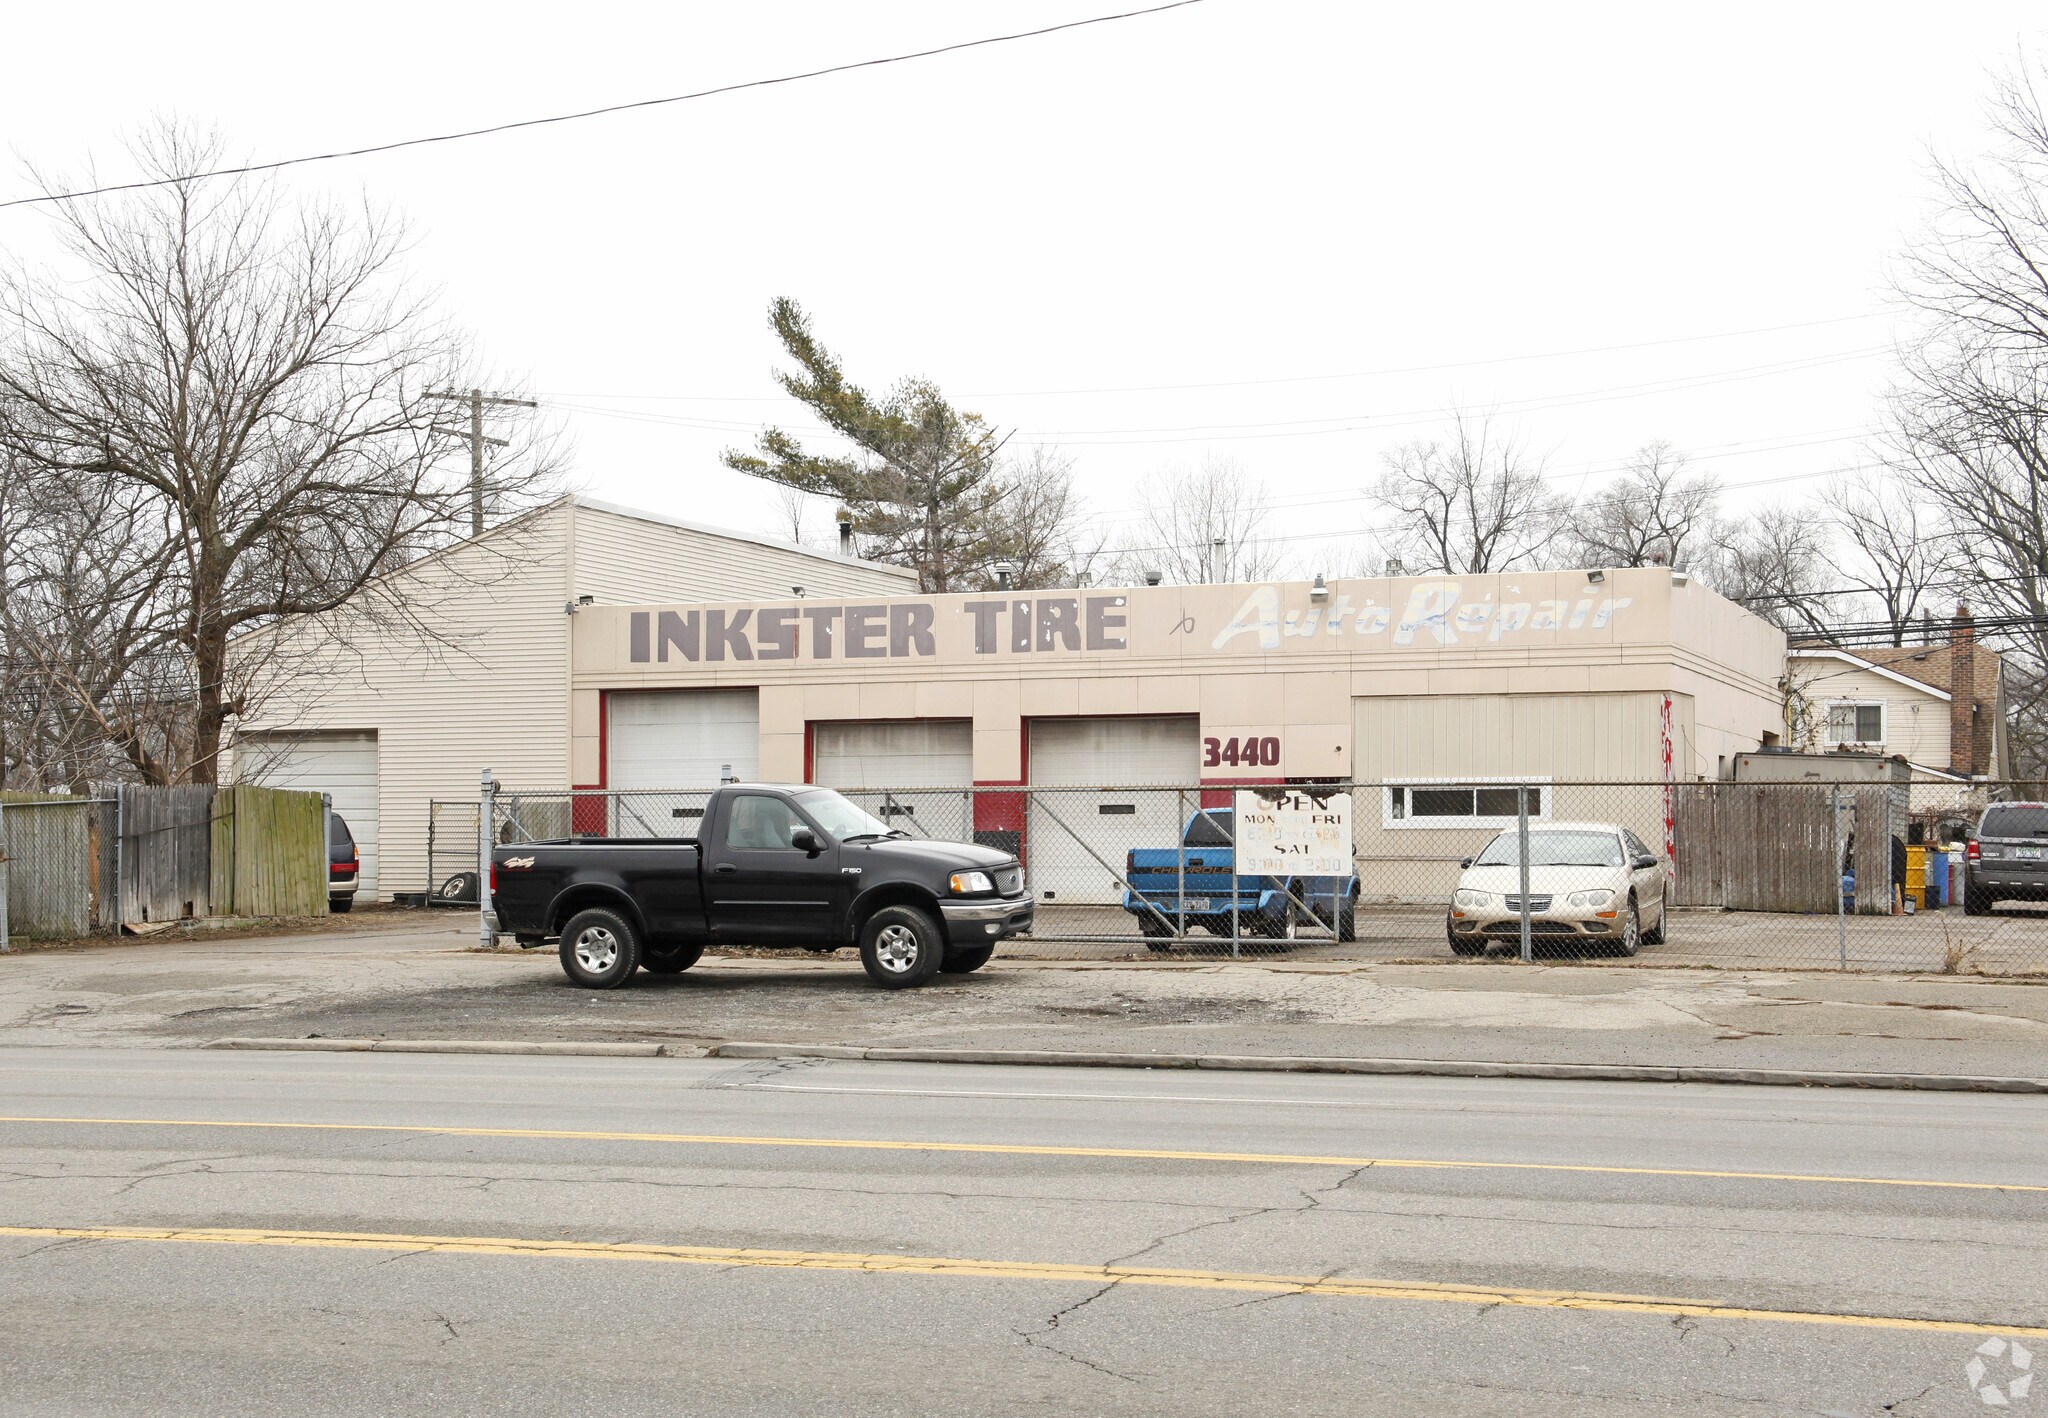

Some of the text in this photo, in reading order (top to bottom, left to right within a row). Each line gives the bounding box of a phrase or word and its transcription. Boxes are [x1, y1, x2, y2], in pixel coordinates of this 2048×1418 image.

[630, 603, 936, 663] INKSTER
[964, 596, 1127, 655] TIRE
[1211, 585, 1393, 651] Auto
[1393, 582, 1633, 647] Repair
[1203, 737, 1280, 767] 3440
[1256, 795, 1328, 811] OPEN
[1244, 814, 1275, 824] MON
[1312, 814, 1341, 825] FRI
